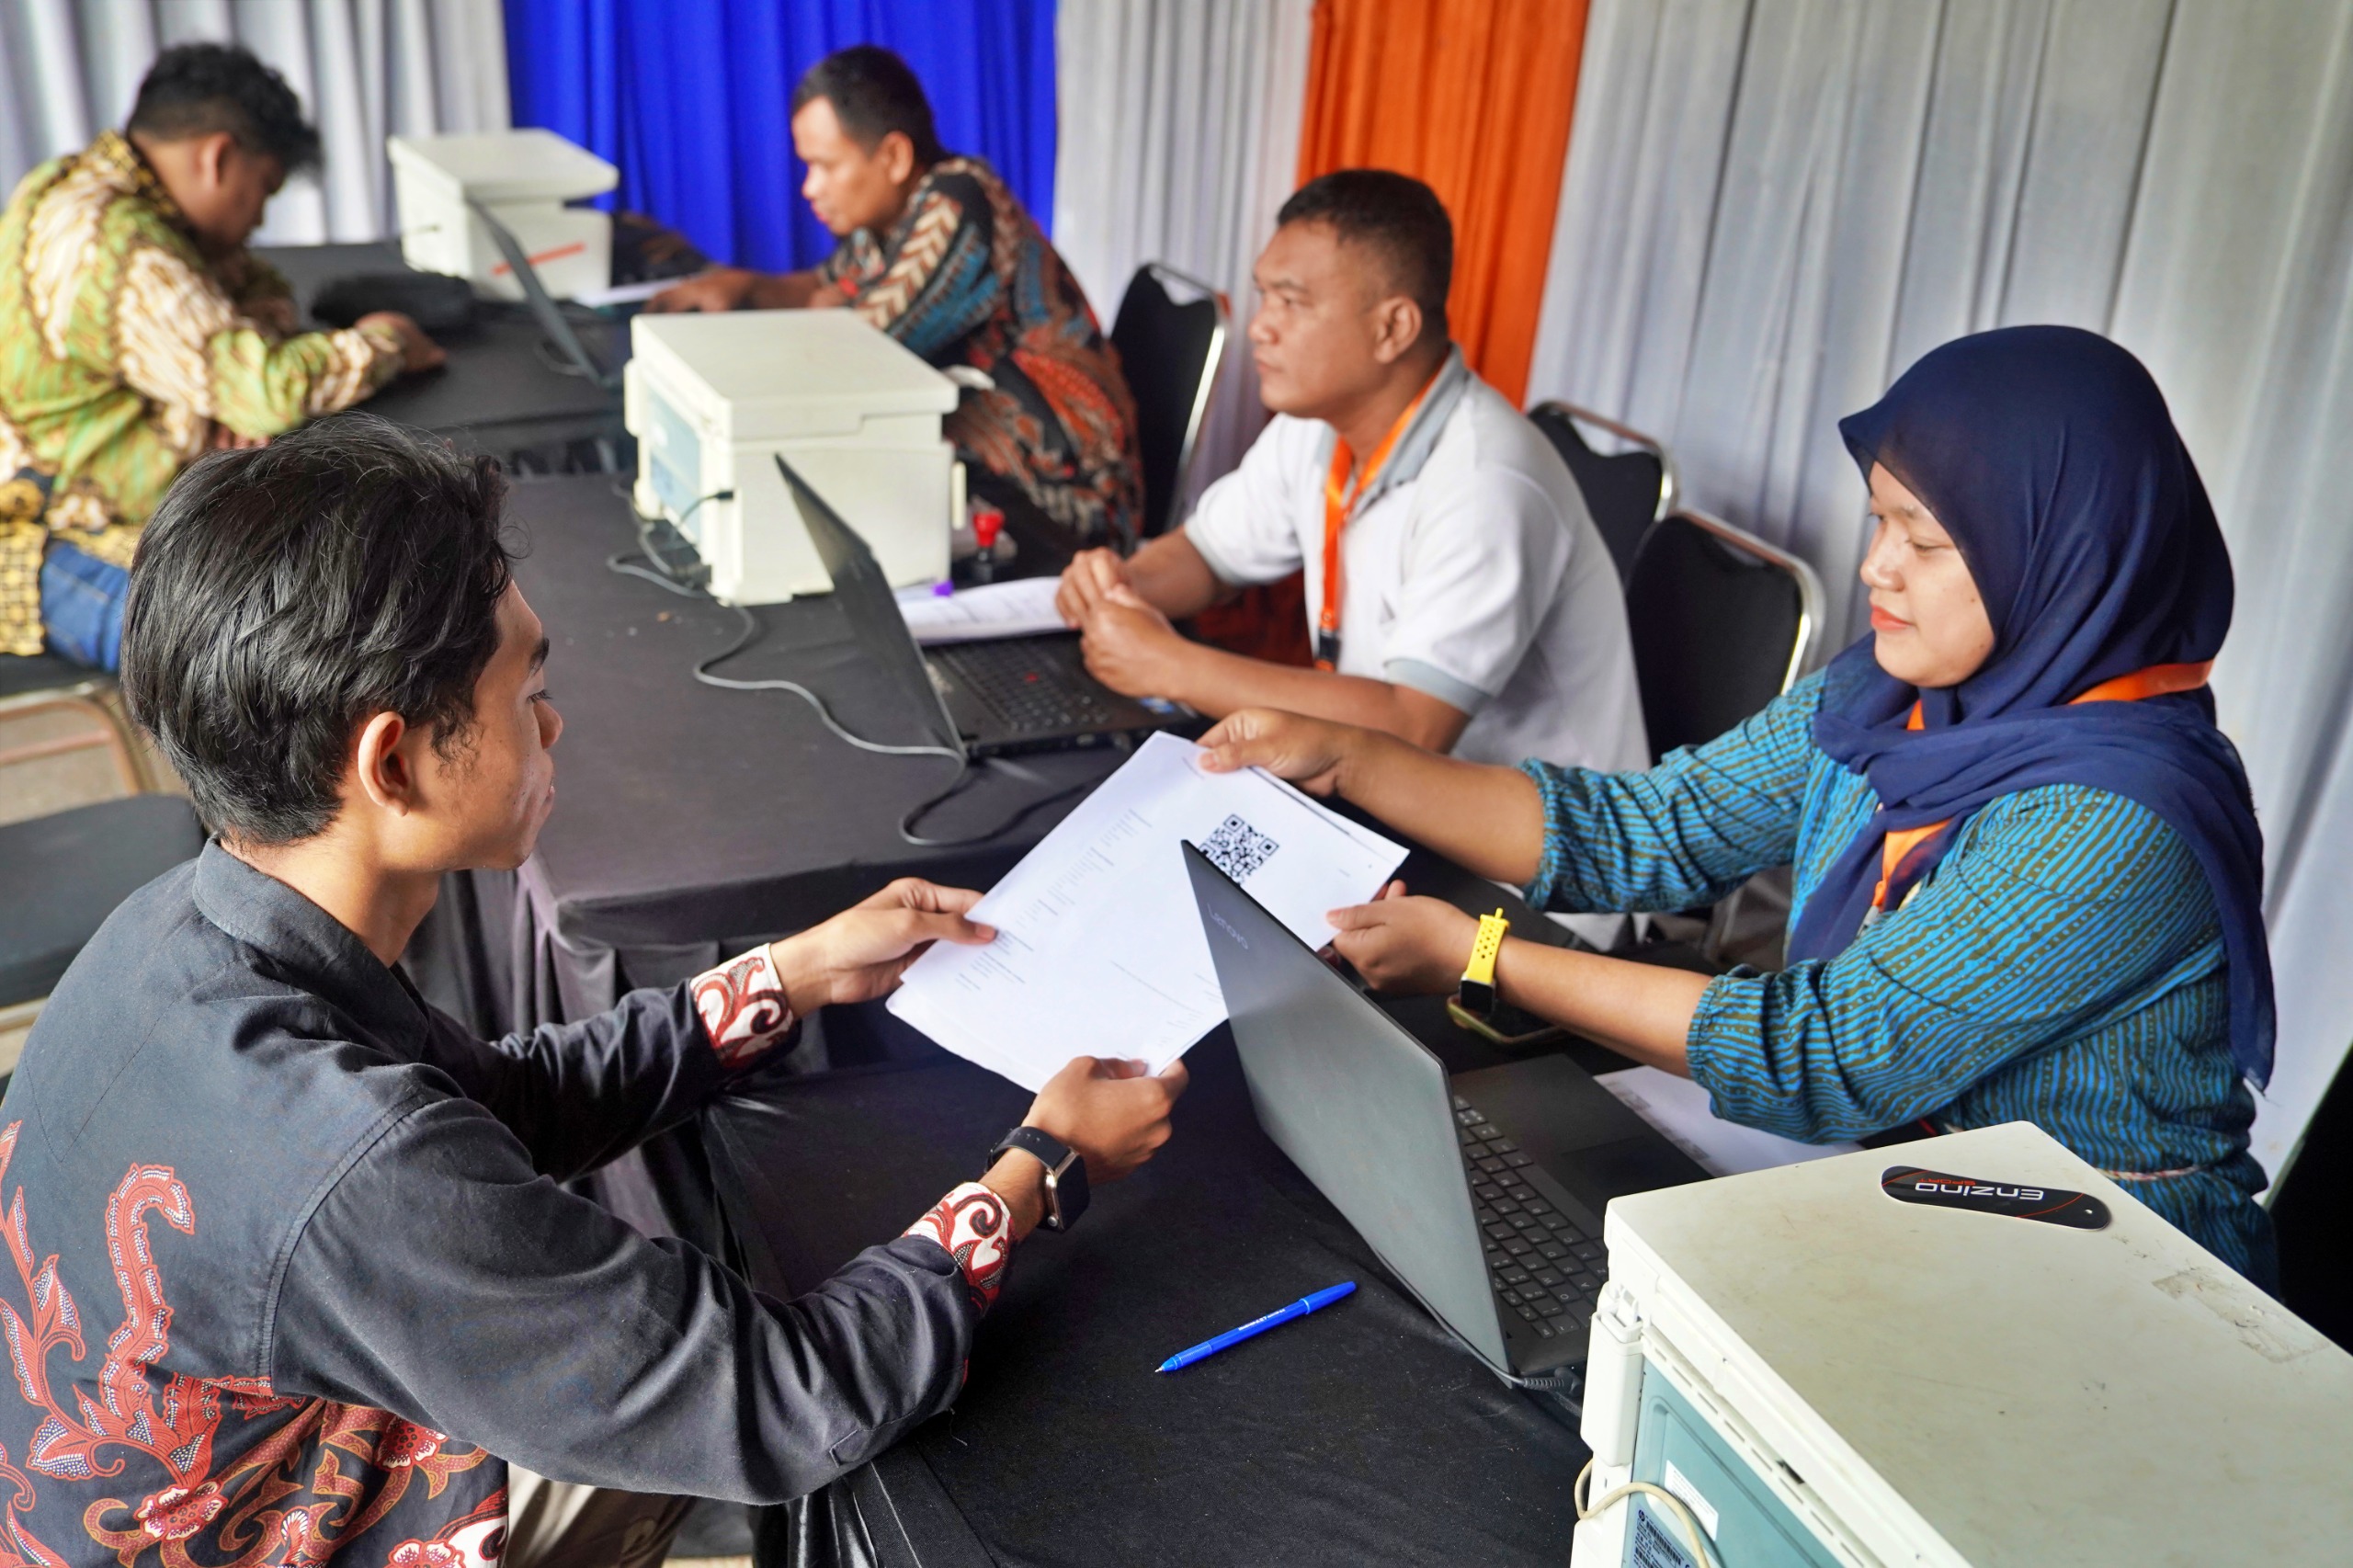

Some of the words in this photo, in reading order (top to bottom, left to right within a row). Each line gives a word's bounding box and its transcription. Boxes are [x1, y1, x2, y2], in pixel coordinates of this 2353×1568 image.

[1206, 903, 1249, 950] Lenovo
[1914, 1181, 2045, 1201] Enzino
[1919, 1177, 1977, 1187] SPORT
